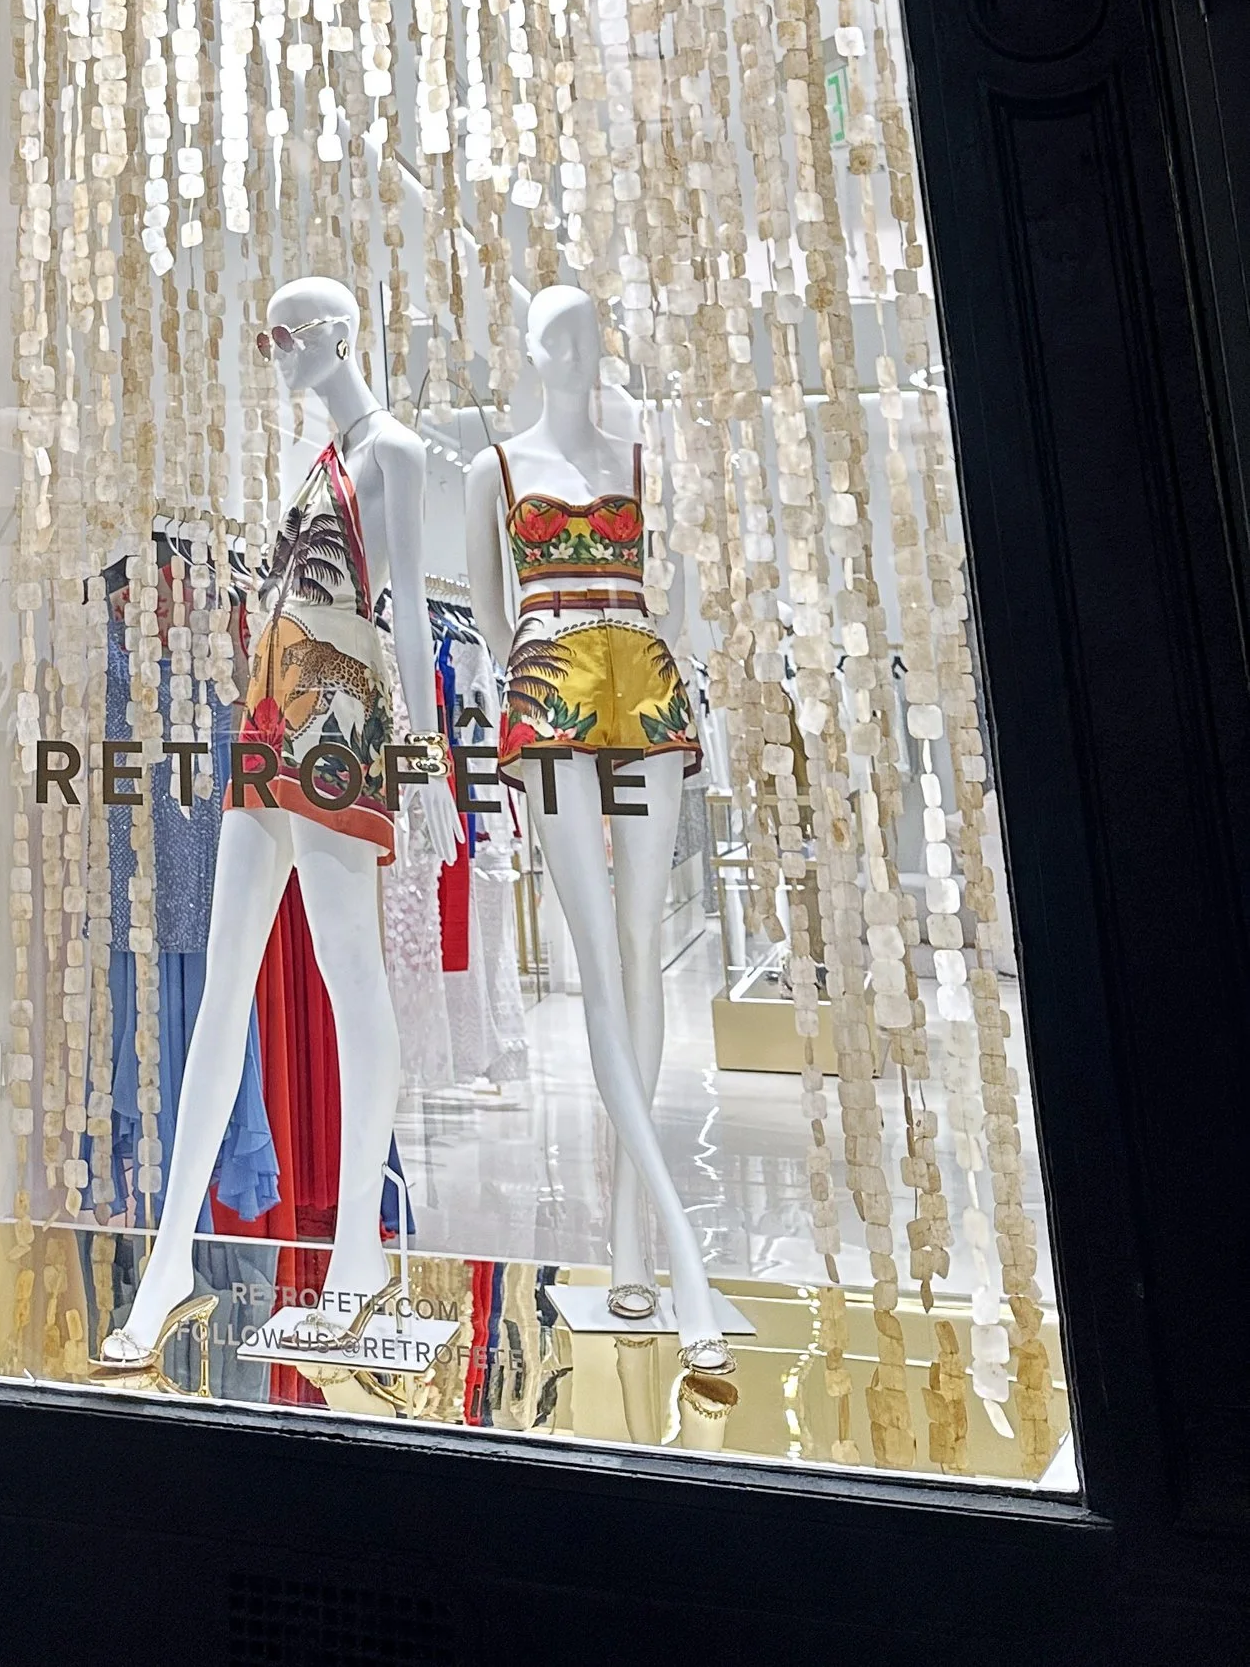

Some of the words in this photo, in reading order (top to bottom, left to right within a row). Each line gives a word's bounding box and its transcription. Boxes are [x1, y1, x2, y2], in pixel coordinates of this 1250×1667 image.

[35, 707, 649, 817] RETROFÊTE
[231, 1282, 459, 1322] RETROFETE.COM
[176, 1318, 284, 1350] FOLLOW
[296, 1332, 329, 1354] US
[342, 1336, 524, 1371] @RETROFETE
